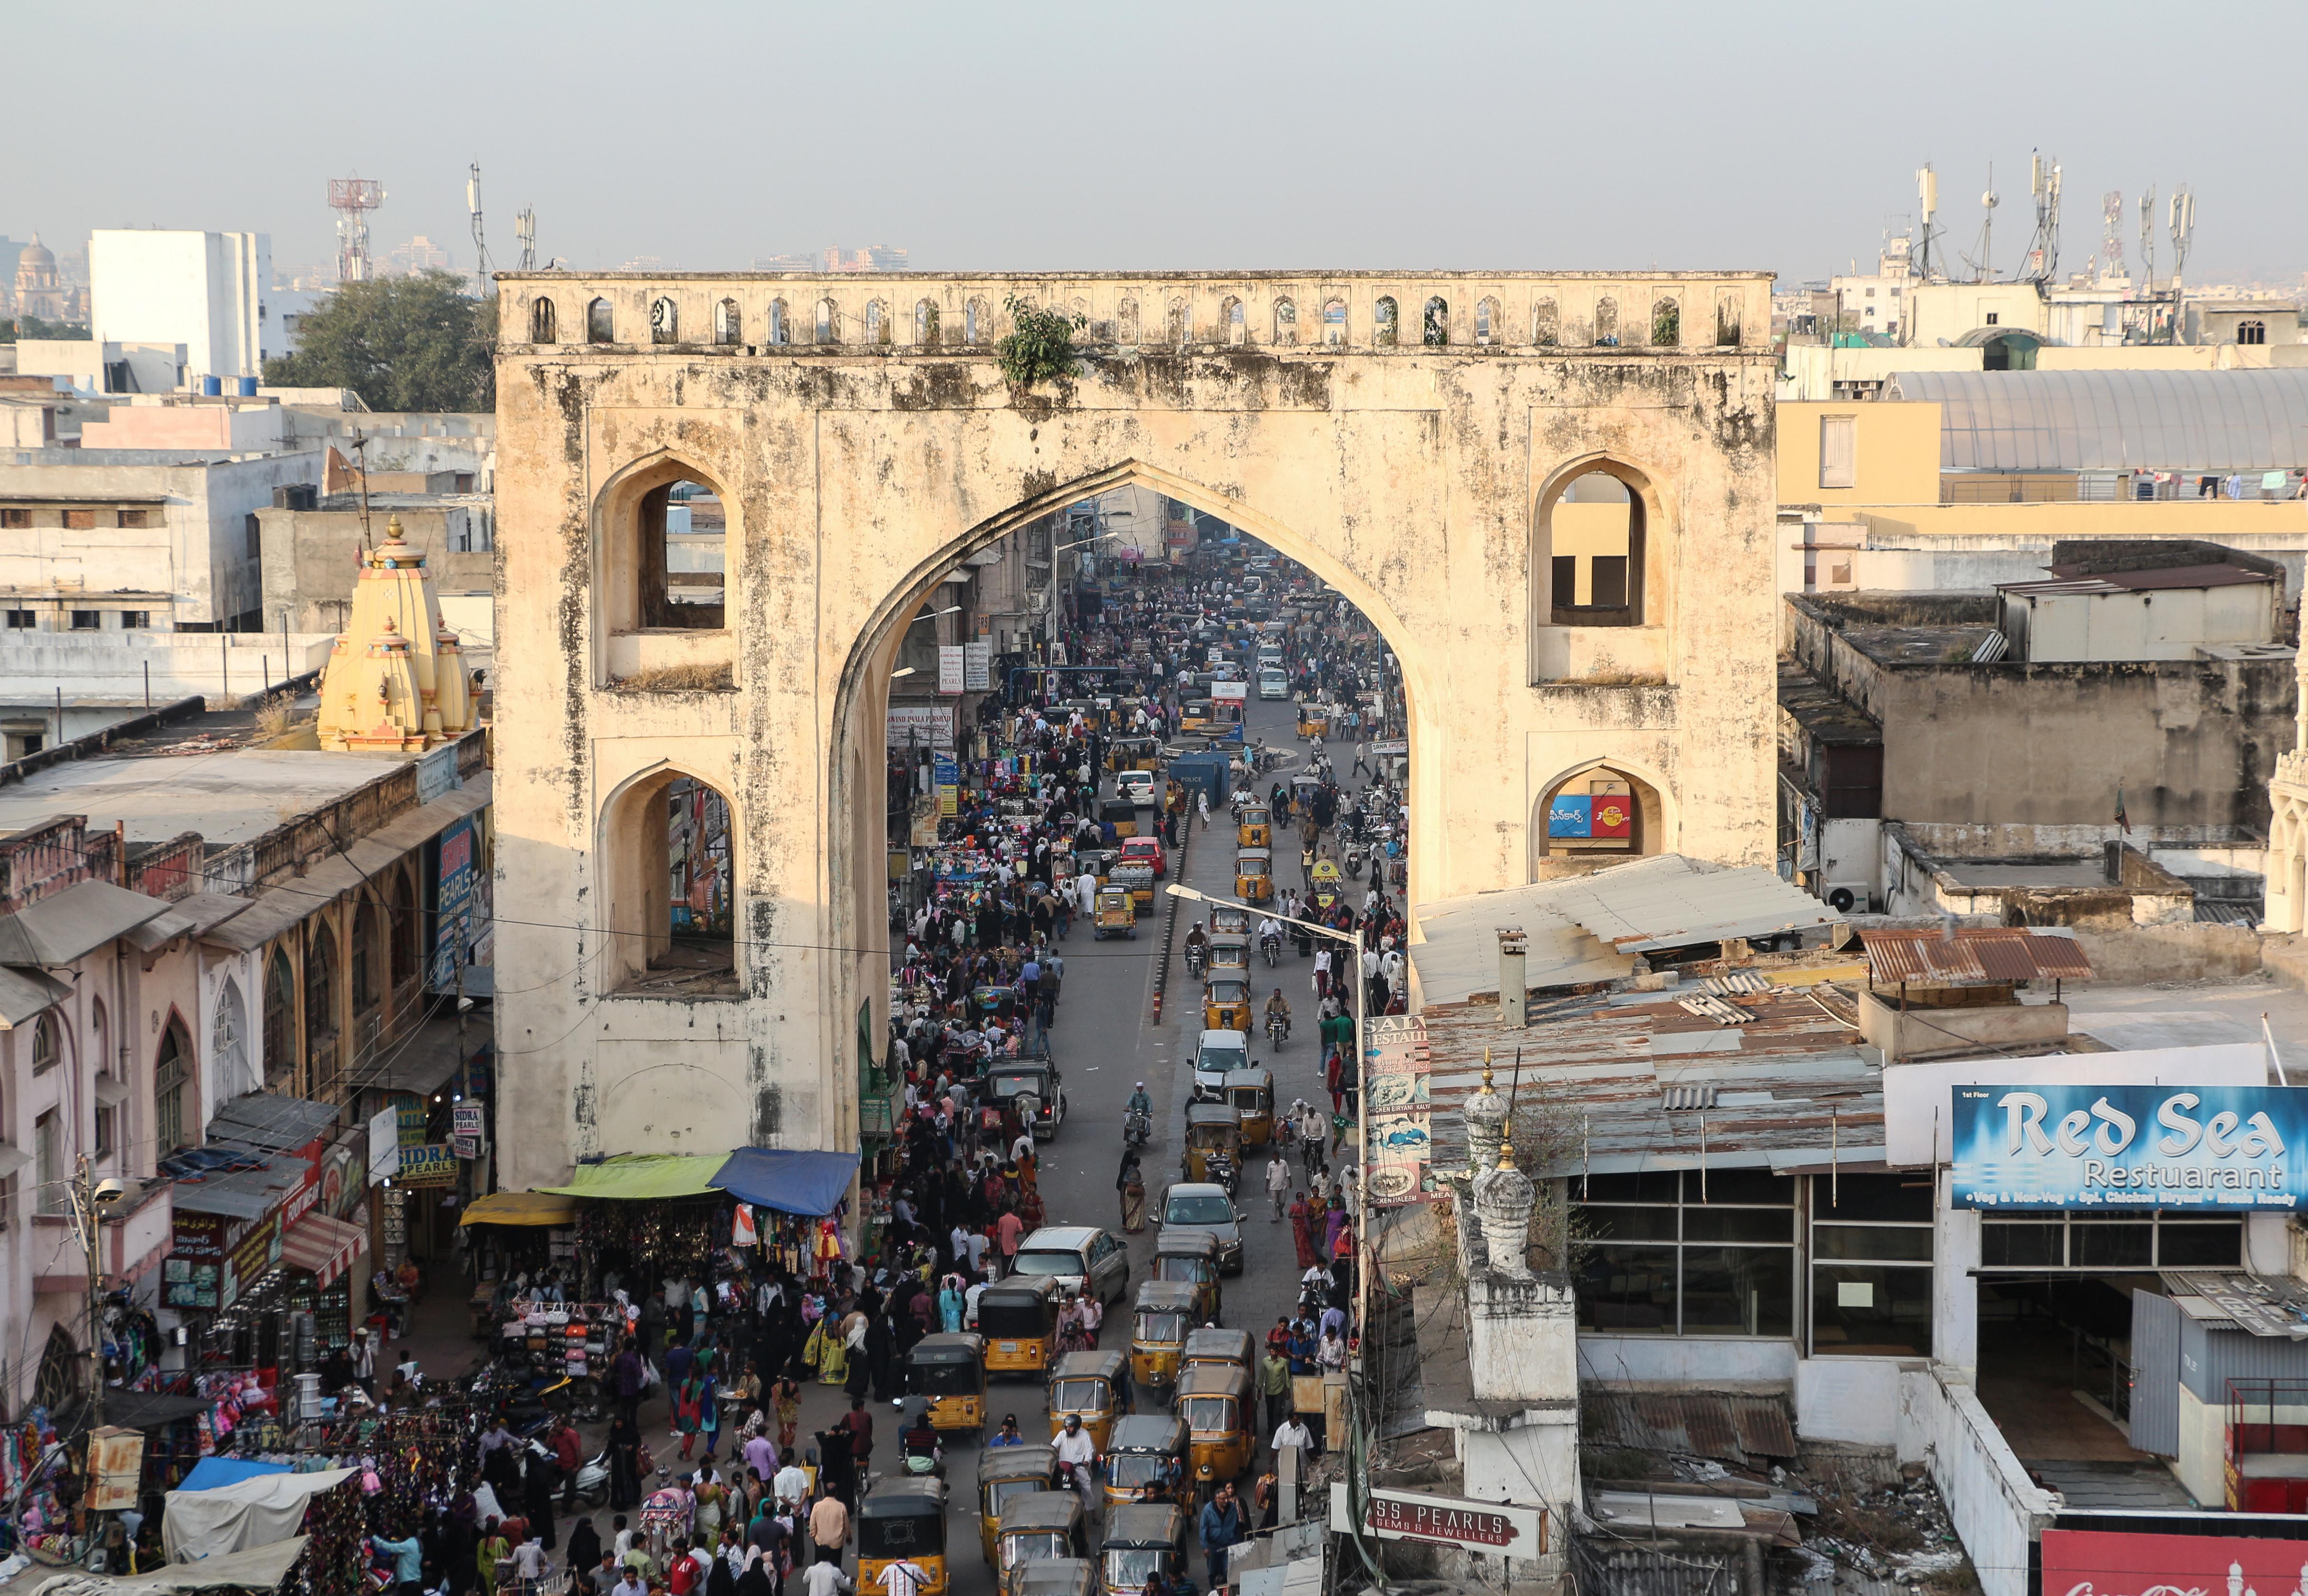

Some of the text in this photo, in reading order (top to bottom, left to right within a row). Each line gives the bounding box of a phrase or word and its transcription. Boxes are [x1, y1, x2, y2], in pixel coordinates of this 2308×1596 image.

[1596, 812, 1603, 821] 3
[439, 867, 471, 912] PEARLS
[1365, 1058, 1400, 1067] FAMILY
[1404, 1064, 1430, 1072] FIRST
[455, 1109, 478, 1120] SIDRA
[1367, 1106, 1390, 1114] CHICKEN
[1392, 1104, 1414, 1112] BIRYANI
[455, 1120, 479, 1129] PEARLS
[1997, 1092, 2286, 1158] Red Sea
[455, 1138, 473, 1147] SIDRA
[455, 1145, 474, 1153] PEARLS
[398, 1146, 455, 1166] SIDRA
[407, 1160, 457, 1174] PEARLS
[2084, 1159, 2283, 1189] Restuarant
[1393, 1195, 1417, 1203] HALEEM
[1973, 1191, 2297, 1207] Veg & Non-Veg Spl. Chicken Biryani Meals Ready
[1376, 1500, 1502, 1534] SS PEARLS
[1377, 1518, 1410, 1531] GEMS
[1415, 1524, 1422, 1532] &
[1429, 1526, 1502, 1544] JEWELLERS
